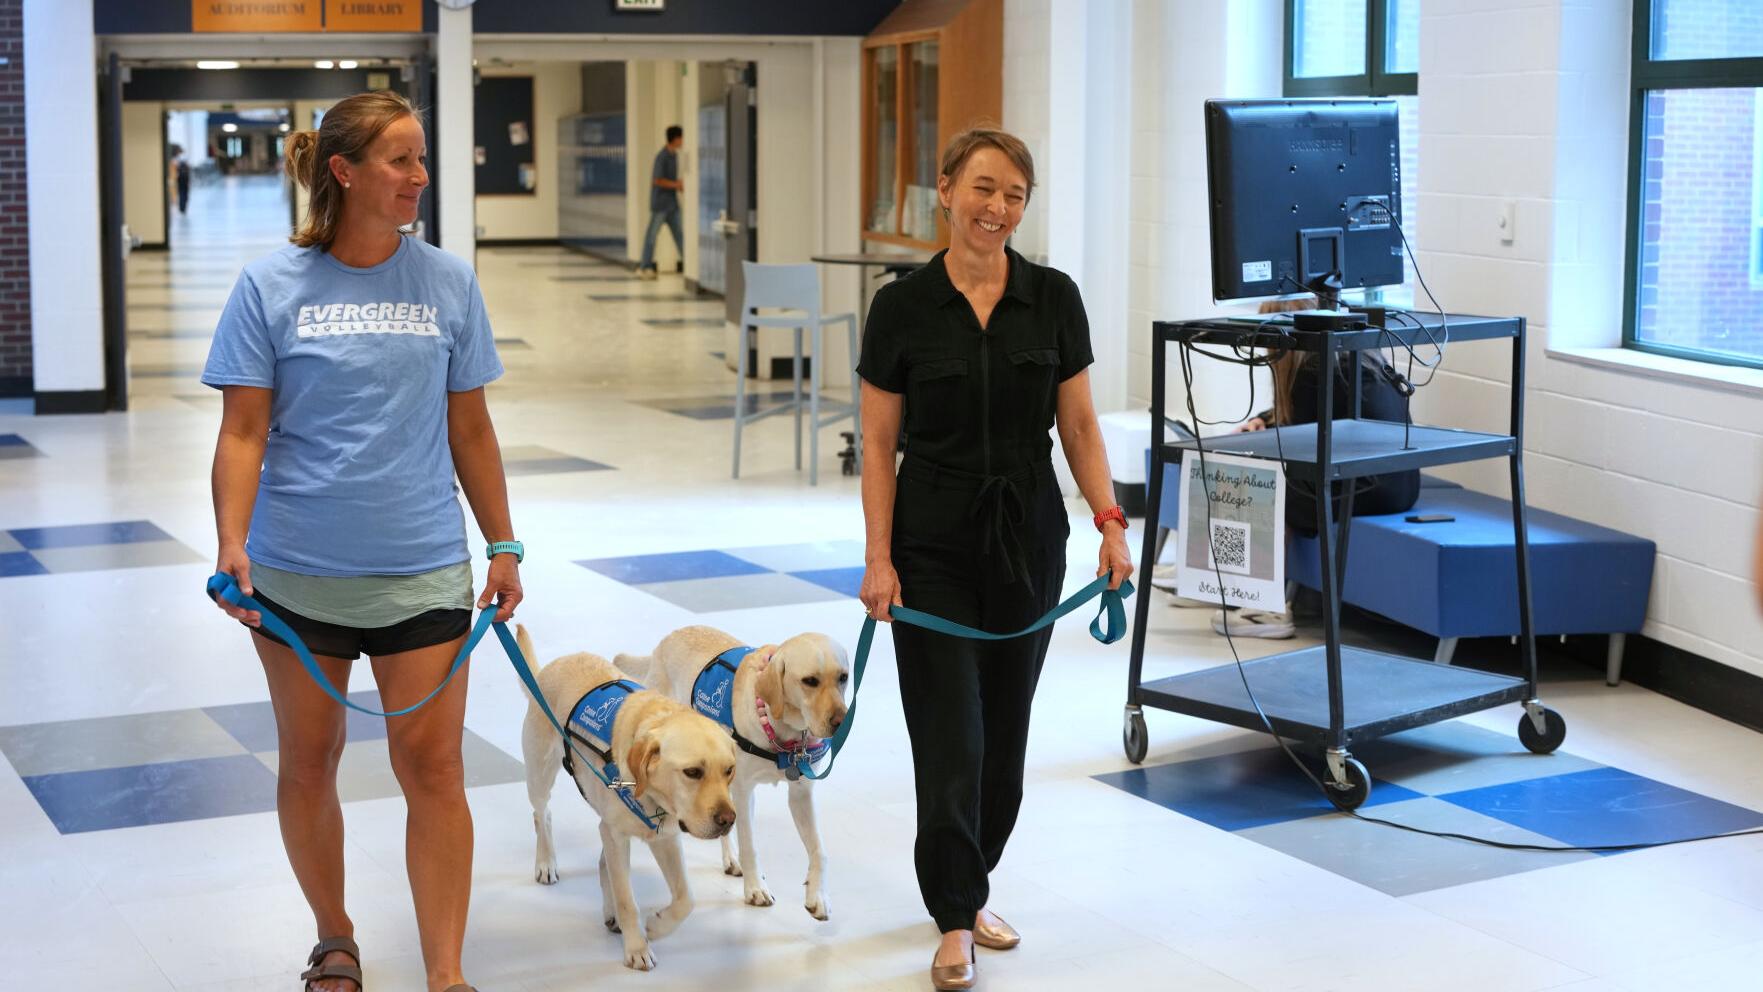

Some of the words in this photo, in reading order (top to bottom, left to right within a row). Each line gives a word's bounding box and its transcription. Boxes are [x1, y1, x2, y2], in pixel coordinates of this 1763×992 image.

[209, 4, 305, 16] AUDITORIUM
[340, 4, 405, 16] LIBRARY
[297, 303, 437, 326] EVERGREEN
[310, 323, 431, 333] VOLLEYBALL
[1190, 468, 1241, 488] Thnking
[1244, 473, 1277, 490] About
[1209, 491, 1253, 509] College?
[1231, 588, 1260, 601] Here!
